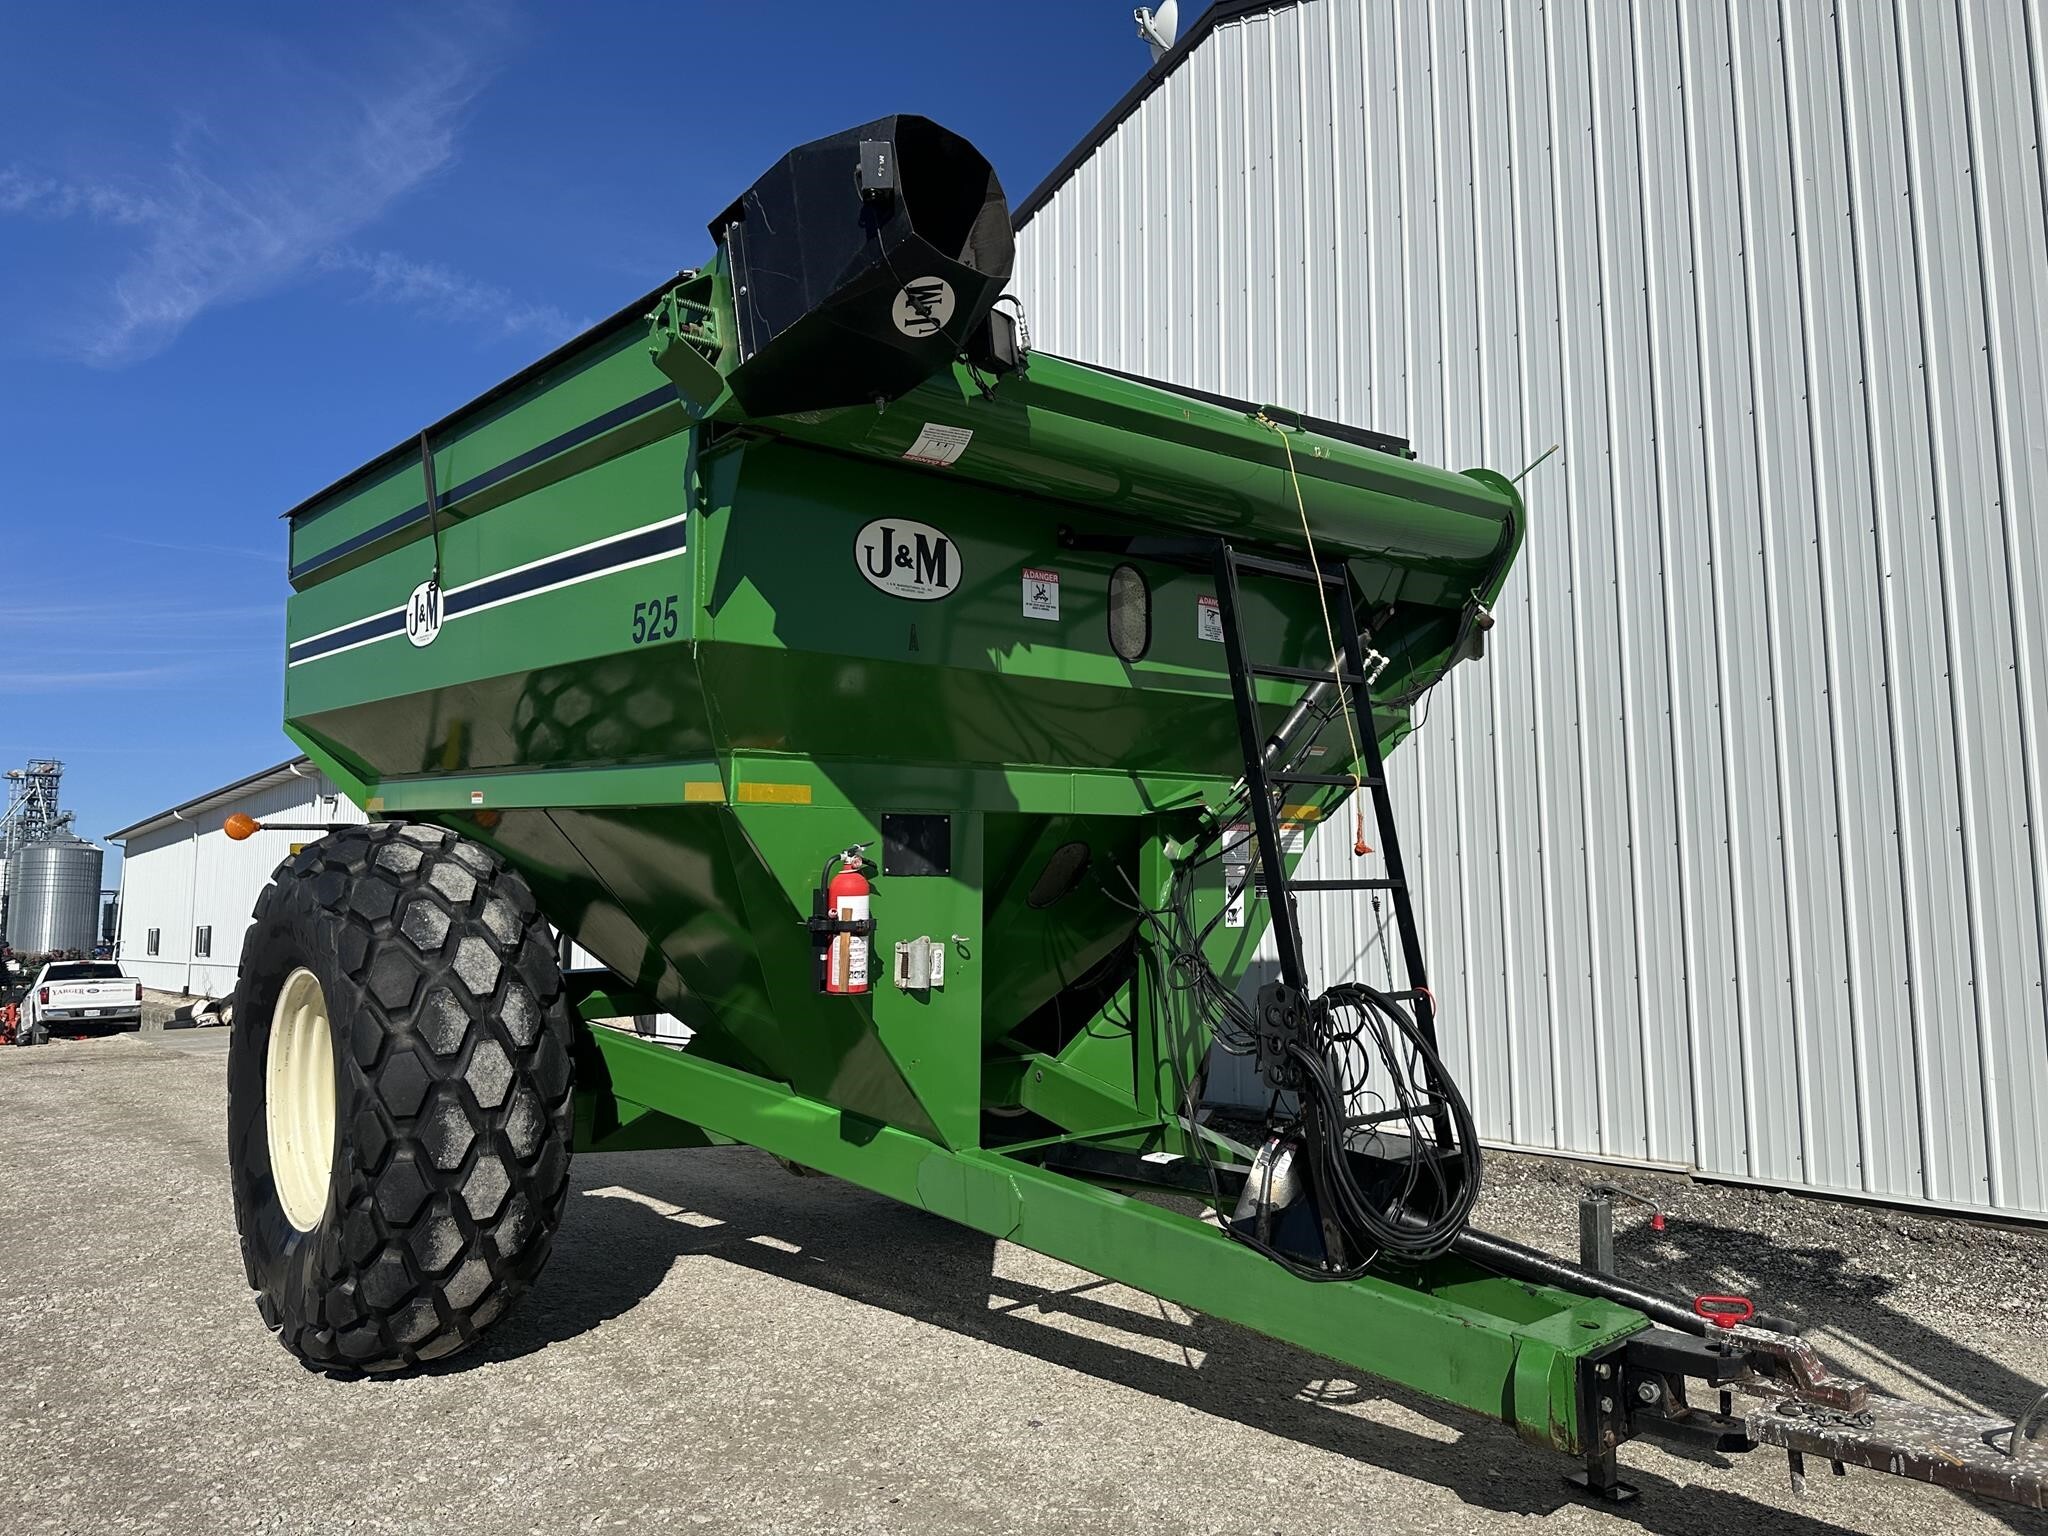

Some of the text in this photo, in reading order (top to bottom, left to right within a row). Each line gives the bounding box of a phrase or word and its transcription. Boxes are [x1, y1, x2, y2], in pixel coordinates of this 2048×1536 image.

[864, 526, 949, 588] J&M
[1030, 571, 1059, 582] DANGER
[409, 590, 438, 636] J&M
[1204, 597, 1219, 607] DANG
[632, 595, 678, 644] 525
[52, 988, 85, 996] YARGER
